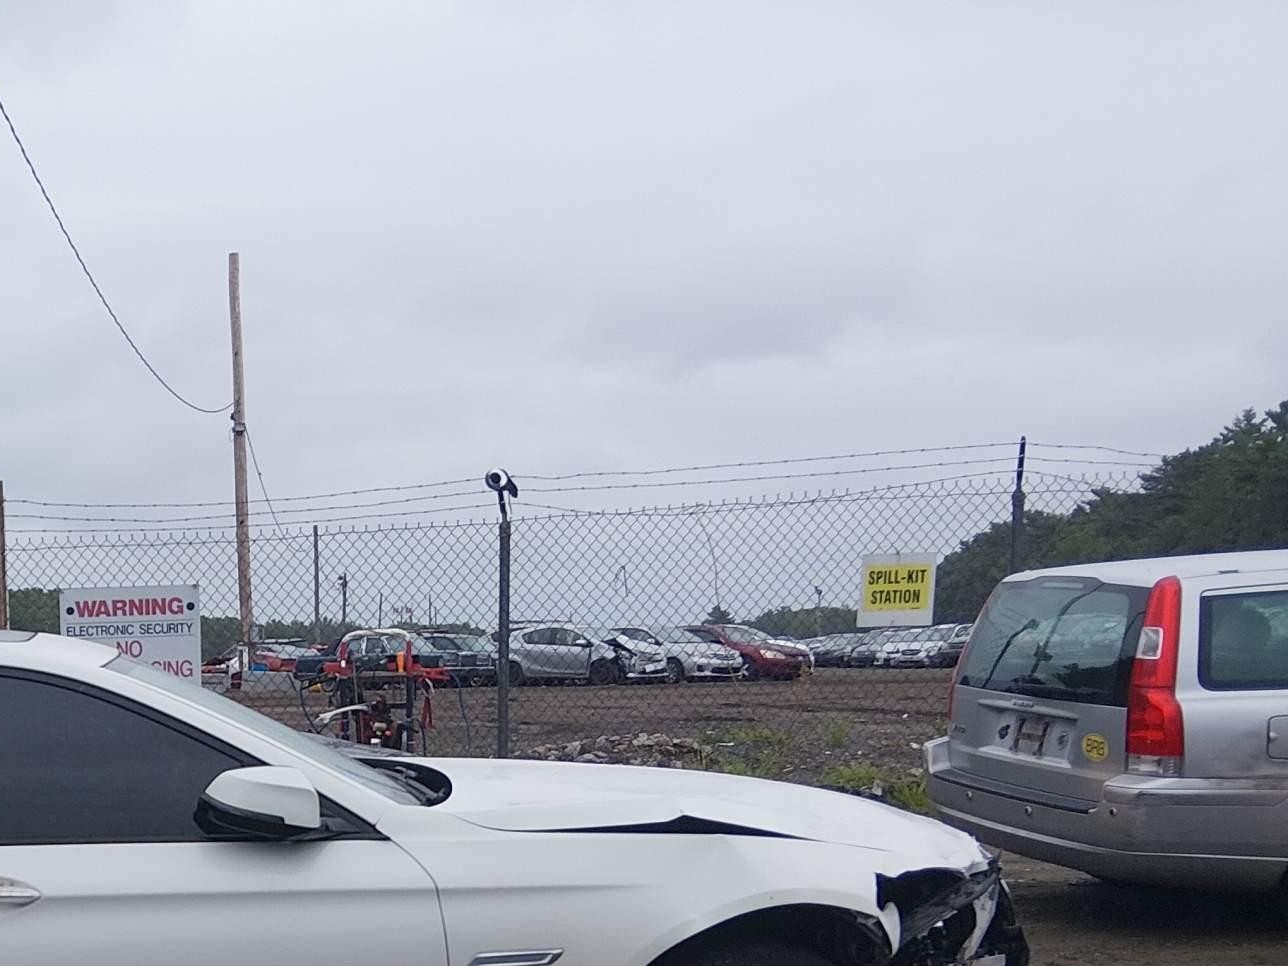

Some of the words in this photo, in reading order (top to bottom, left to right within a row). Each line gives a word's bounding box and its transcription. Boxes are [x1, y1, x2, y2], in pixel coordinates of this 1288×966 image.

[868, 569, 927, 585] SPILL-KIT
[870, 589, 921, 605] STATION
[74, 597, 184, 618] WARNING
[66, 624, 134, 637] ELECTRONIC
[139, 622, 193, 635] SECURITY
[116, 640, 143, 658] NO
